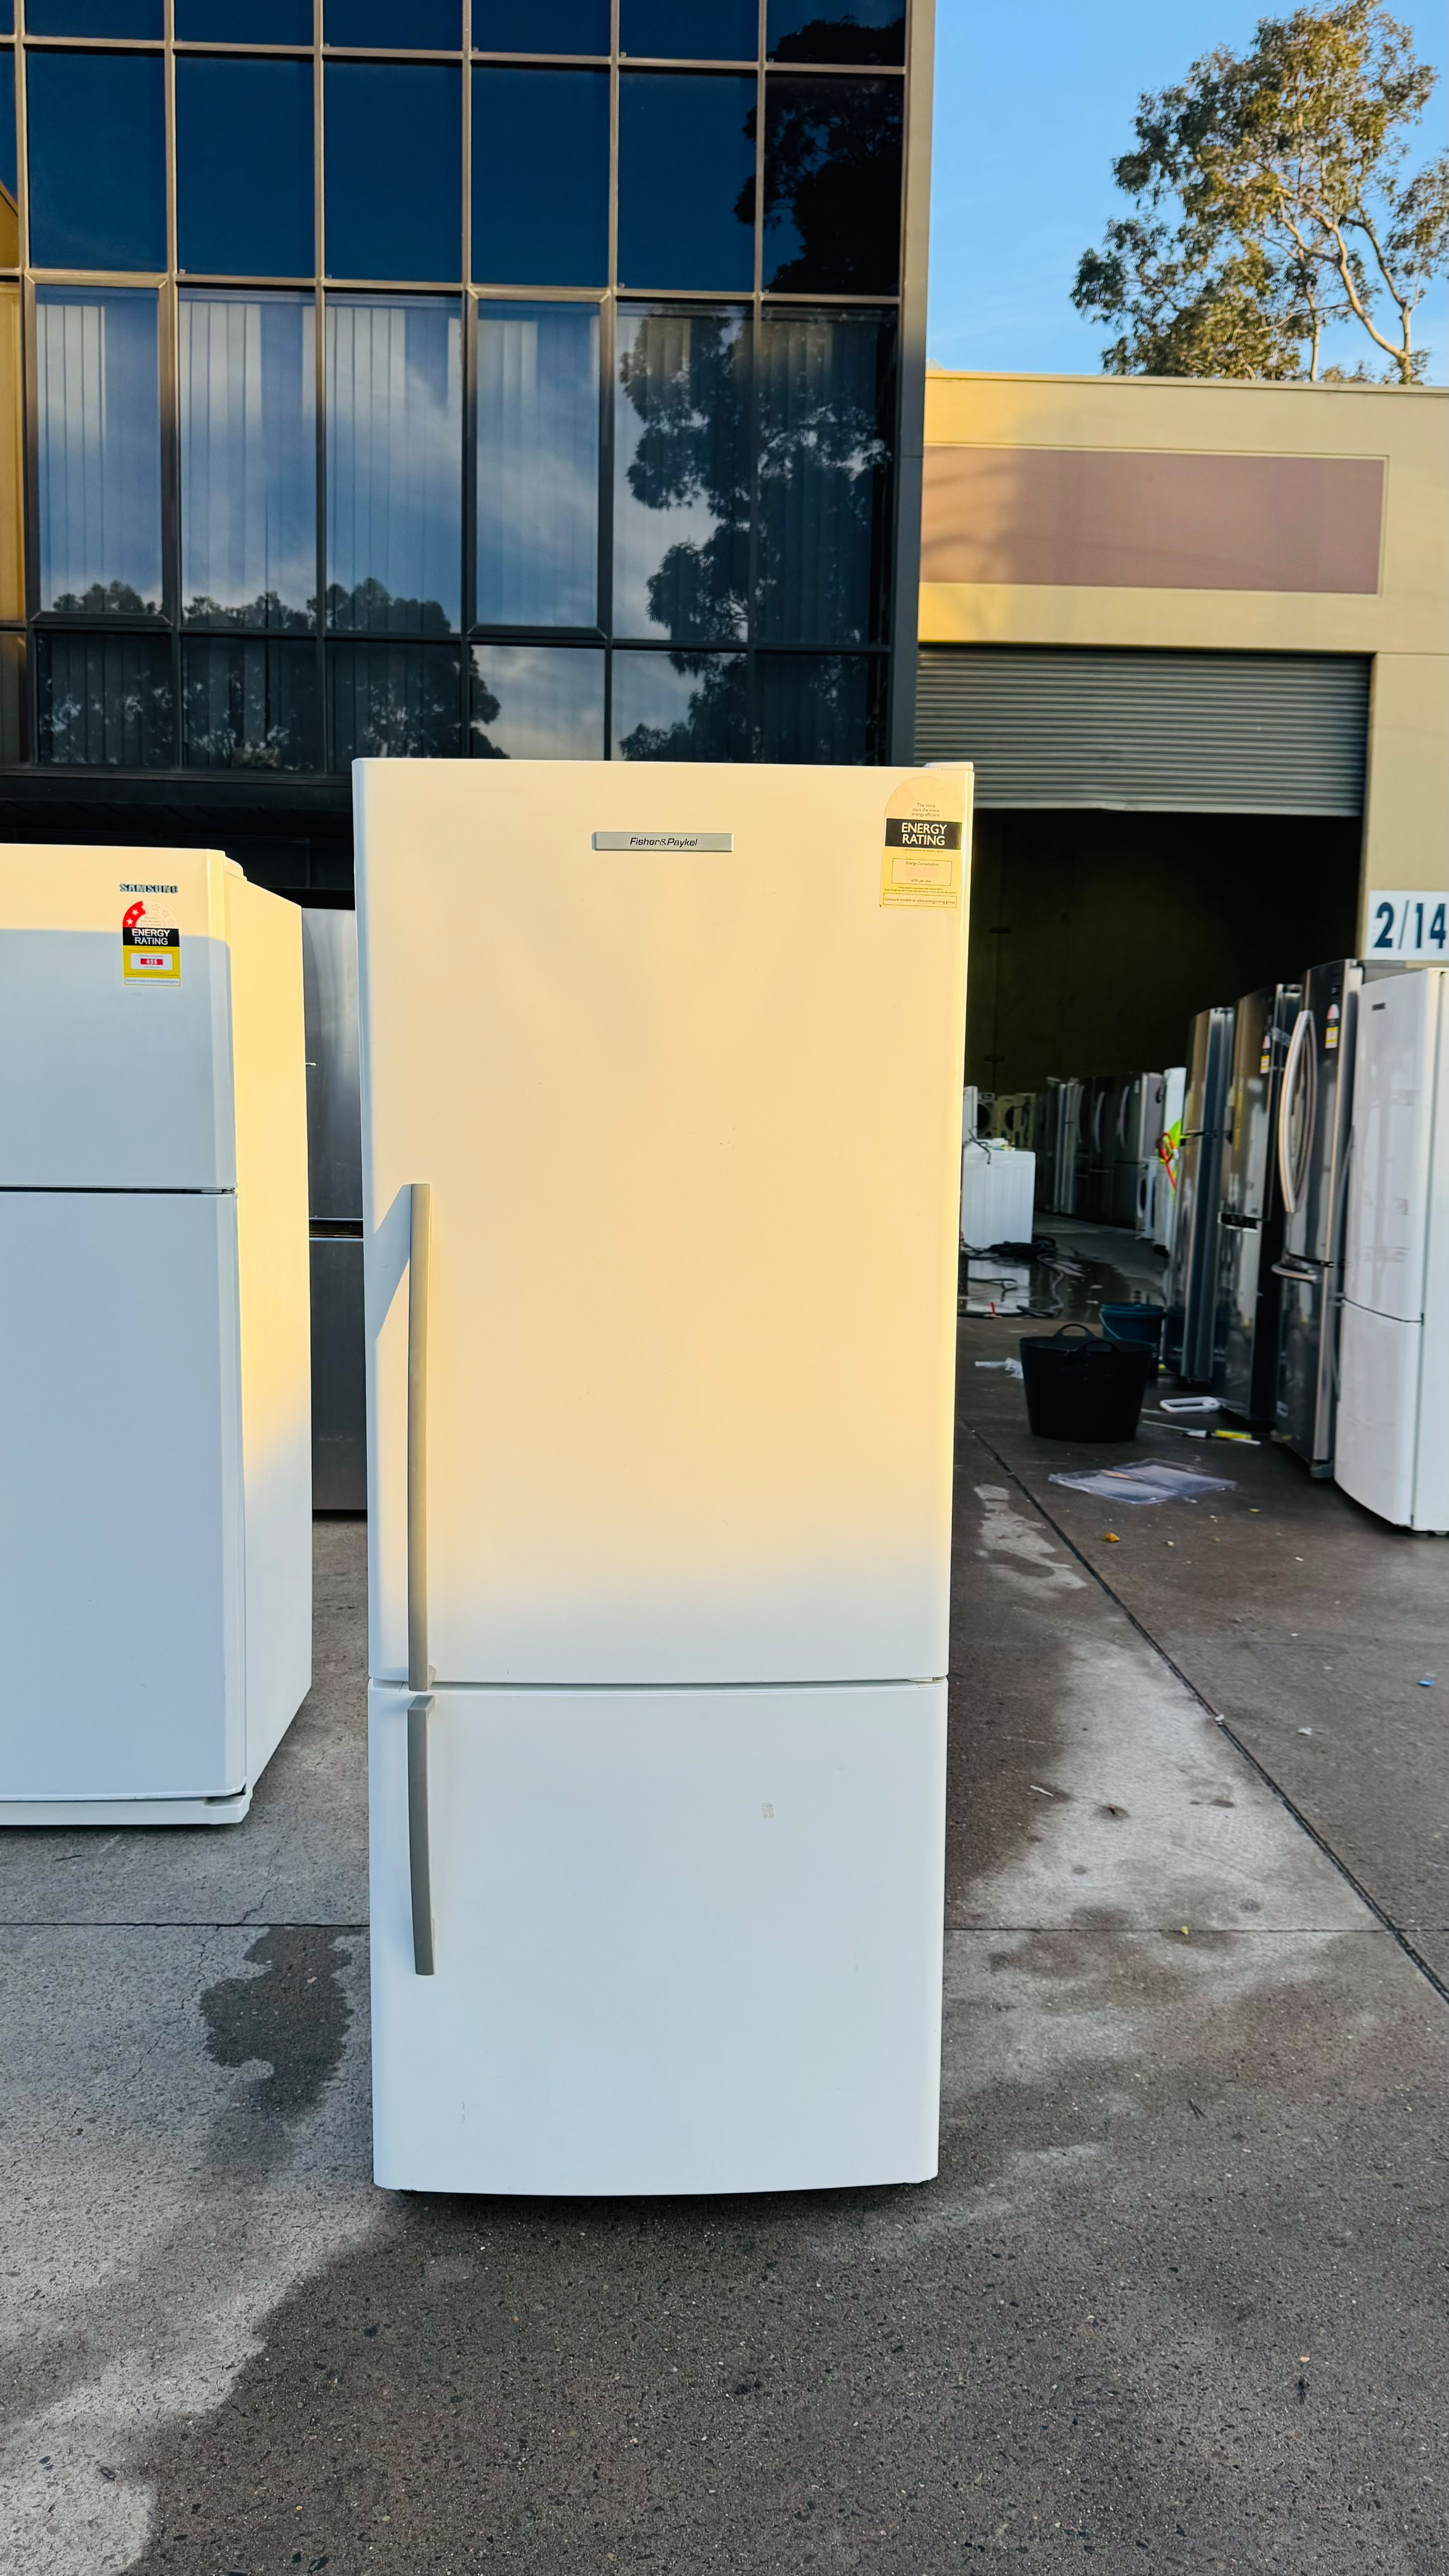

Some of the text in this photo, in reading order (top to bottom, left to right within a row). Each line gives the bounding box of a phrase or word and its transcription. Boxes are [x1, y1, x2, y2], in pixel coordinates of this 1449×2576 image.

[901, 822, 947, 835] ENERGY
[630, 837, 698, 848] Fisher&Paykel
[902, 834, 945, 846] RATING
[119, 883, 178, 894] SAMSUNG
[1373, 899, 1446, 950] 2/14
[131, 928, 171, 937] ENERGY
[134, 937, 168, 945] RATING
